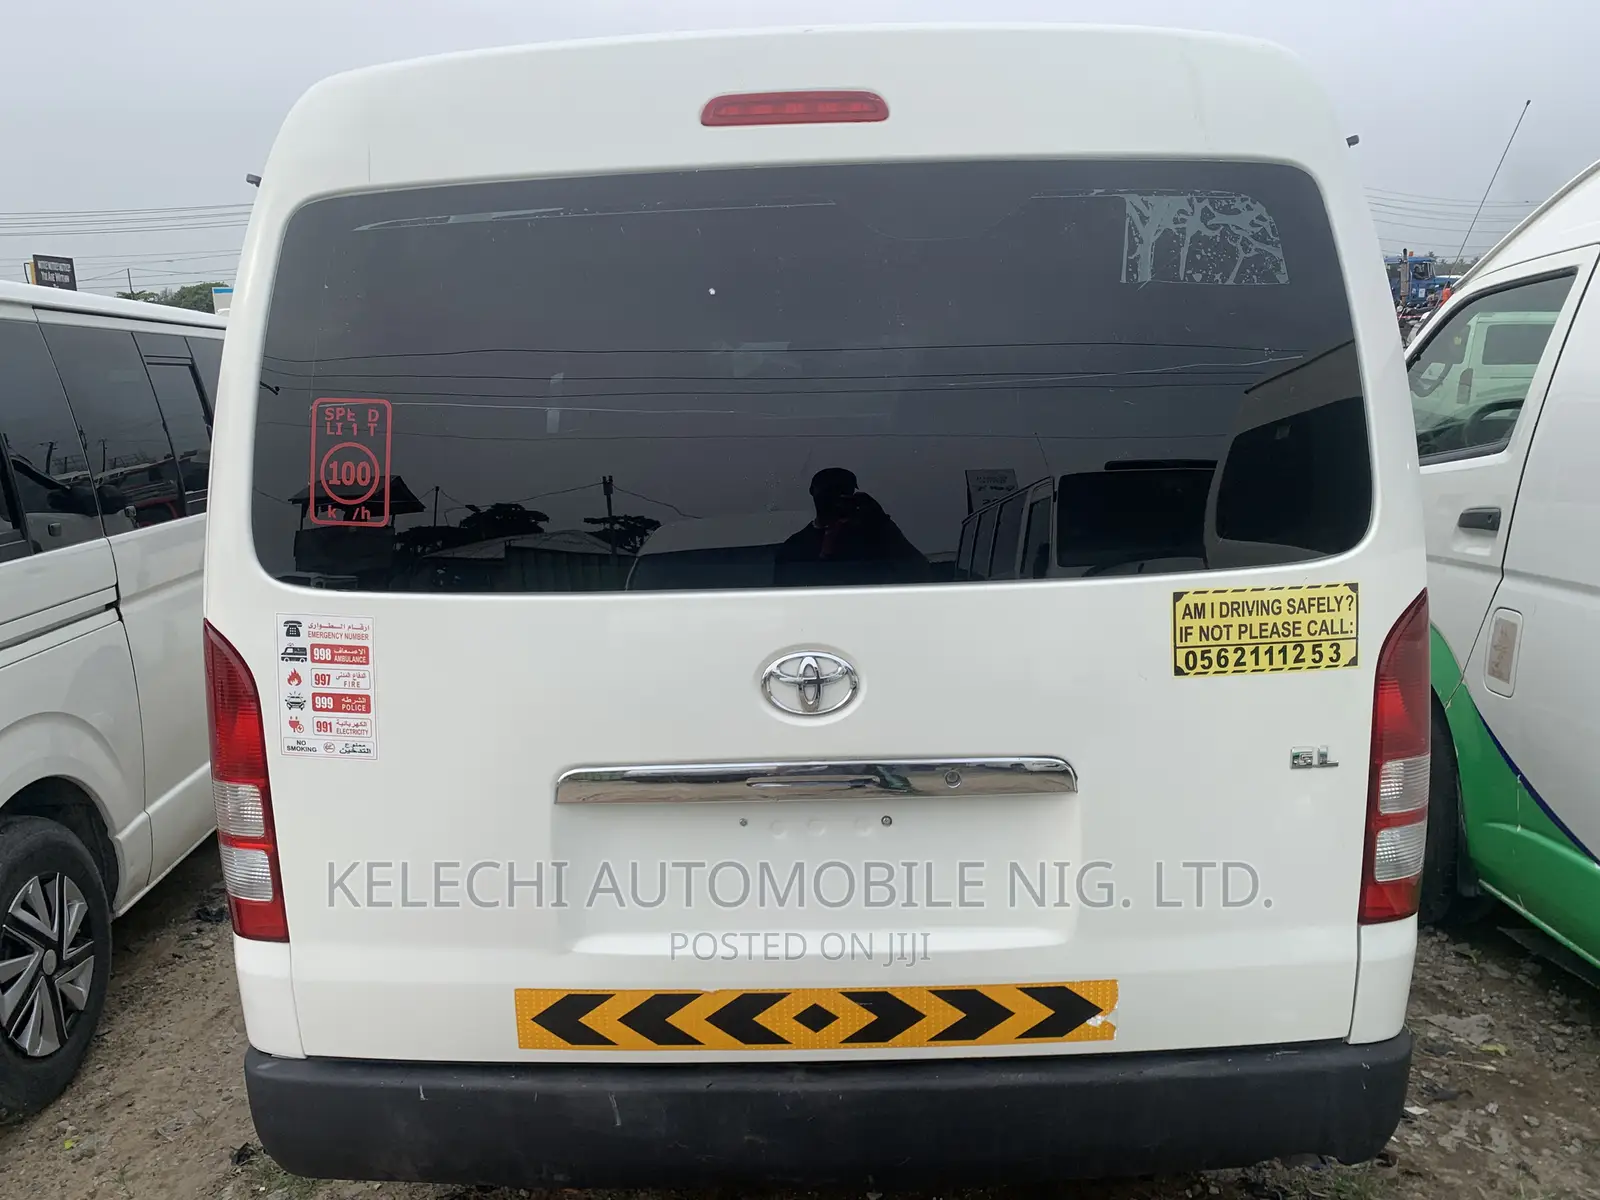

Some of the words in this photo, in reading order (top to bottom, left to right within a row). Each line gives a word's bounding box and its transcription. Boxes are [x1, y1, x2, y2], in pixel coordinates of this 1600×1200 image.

[324, 407, 380, 422] SPED
[328, 461, 371, 486] 100
[327, 505, 371, 520] k/h
[1182, 602, 1206, 620] AM
[1210, 602, 1215, 619] I
[1219, 599, 1282, 619] DRIVING
[308, 631, 344, 640] EMERGENCY
[344, 632, 369, 641] NUMBER
[1180, 625, 1194, 643] IF
[1199, 624, 1233, 642] NOT
[1238, 621, 1302, 640] PLEASE
[1307, 618, 1354, 636] CALL:
[313, 648, 332, 661] 998
[334, 654, 366, 664] AMBULANCE
[1184, 643, 1342, 671] 0562111253
[314, 673, 331, 686] 997
[343, 680, 361, 688] FIRE
[315, 696, 333, 709] 999
[341, 704, 366, 712] POLICE
[316, 720, 333, 733] 991
[336, 727, 368, 736] ELECTRICITY
[1290, 746, 1339, 770] GL
